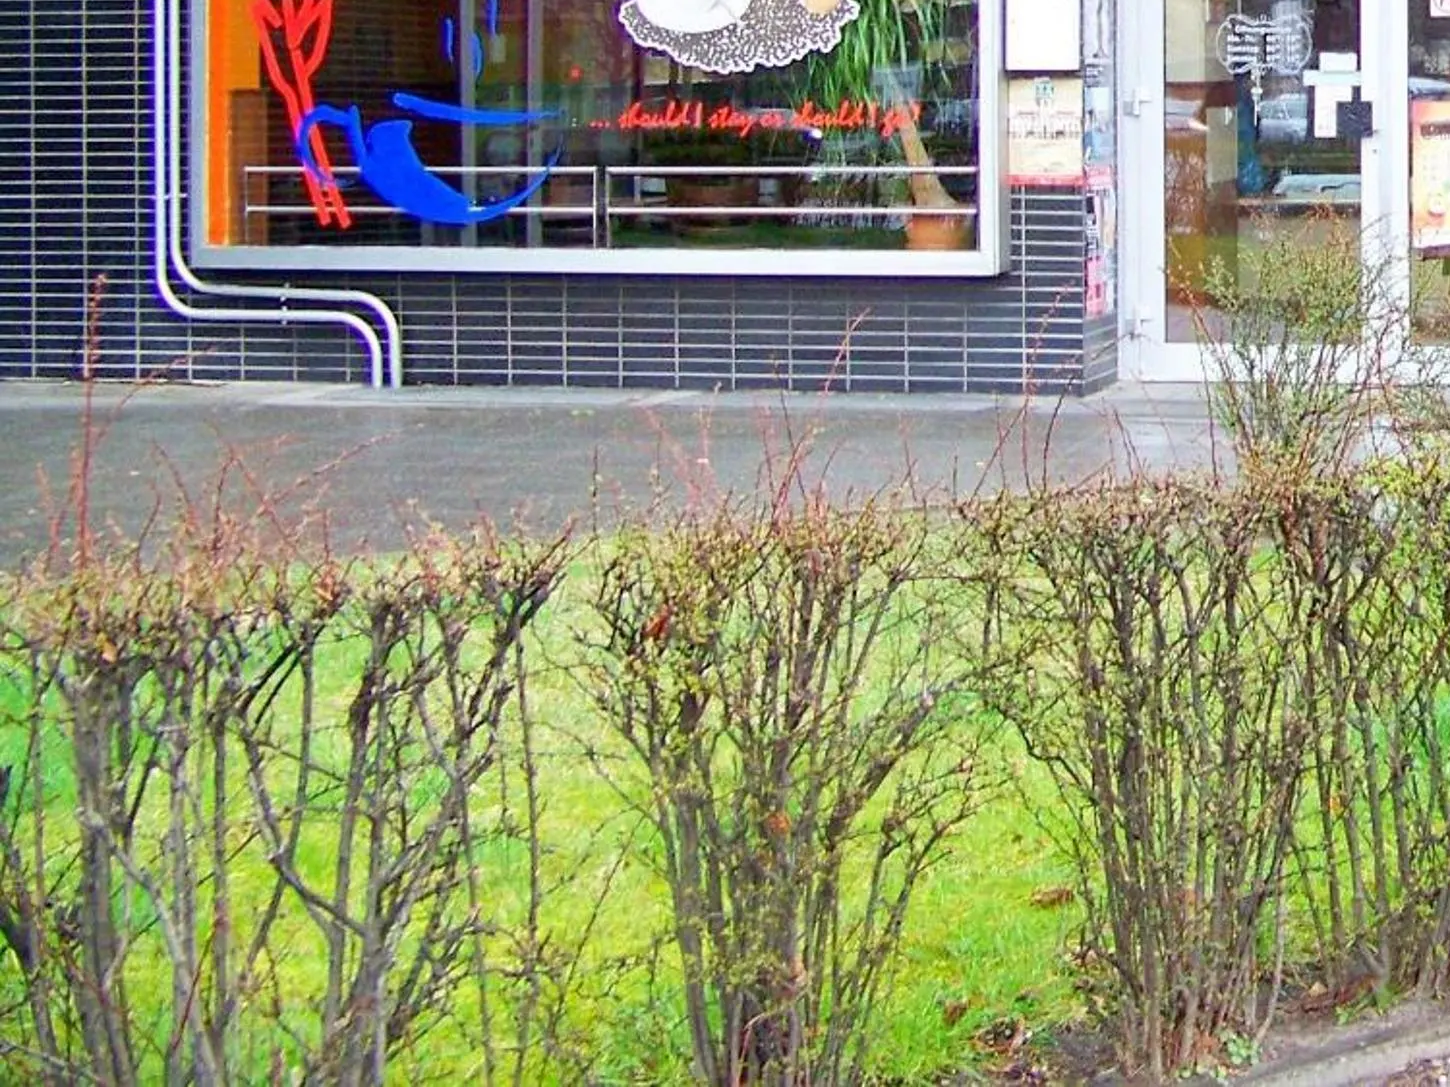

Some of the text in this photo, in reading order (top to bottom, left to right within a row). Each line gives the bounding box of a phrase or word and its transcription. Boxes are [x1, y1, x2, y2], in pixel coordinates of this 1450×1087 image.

[617, 100, 691, 130] should
[707, 102, 751, 138] stay
[758, 109, 785, 130] or
[793, 100, 864, 130] should
